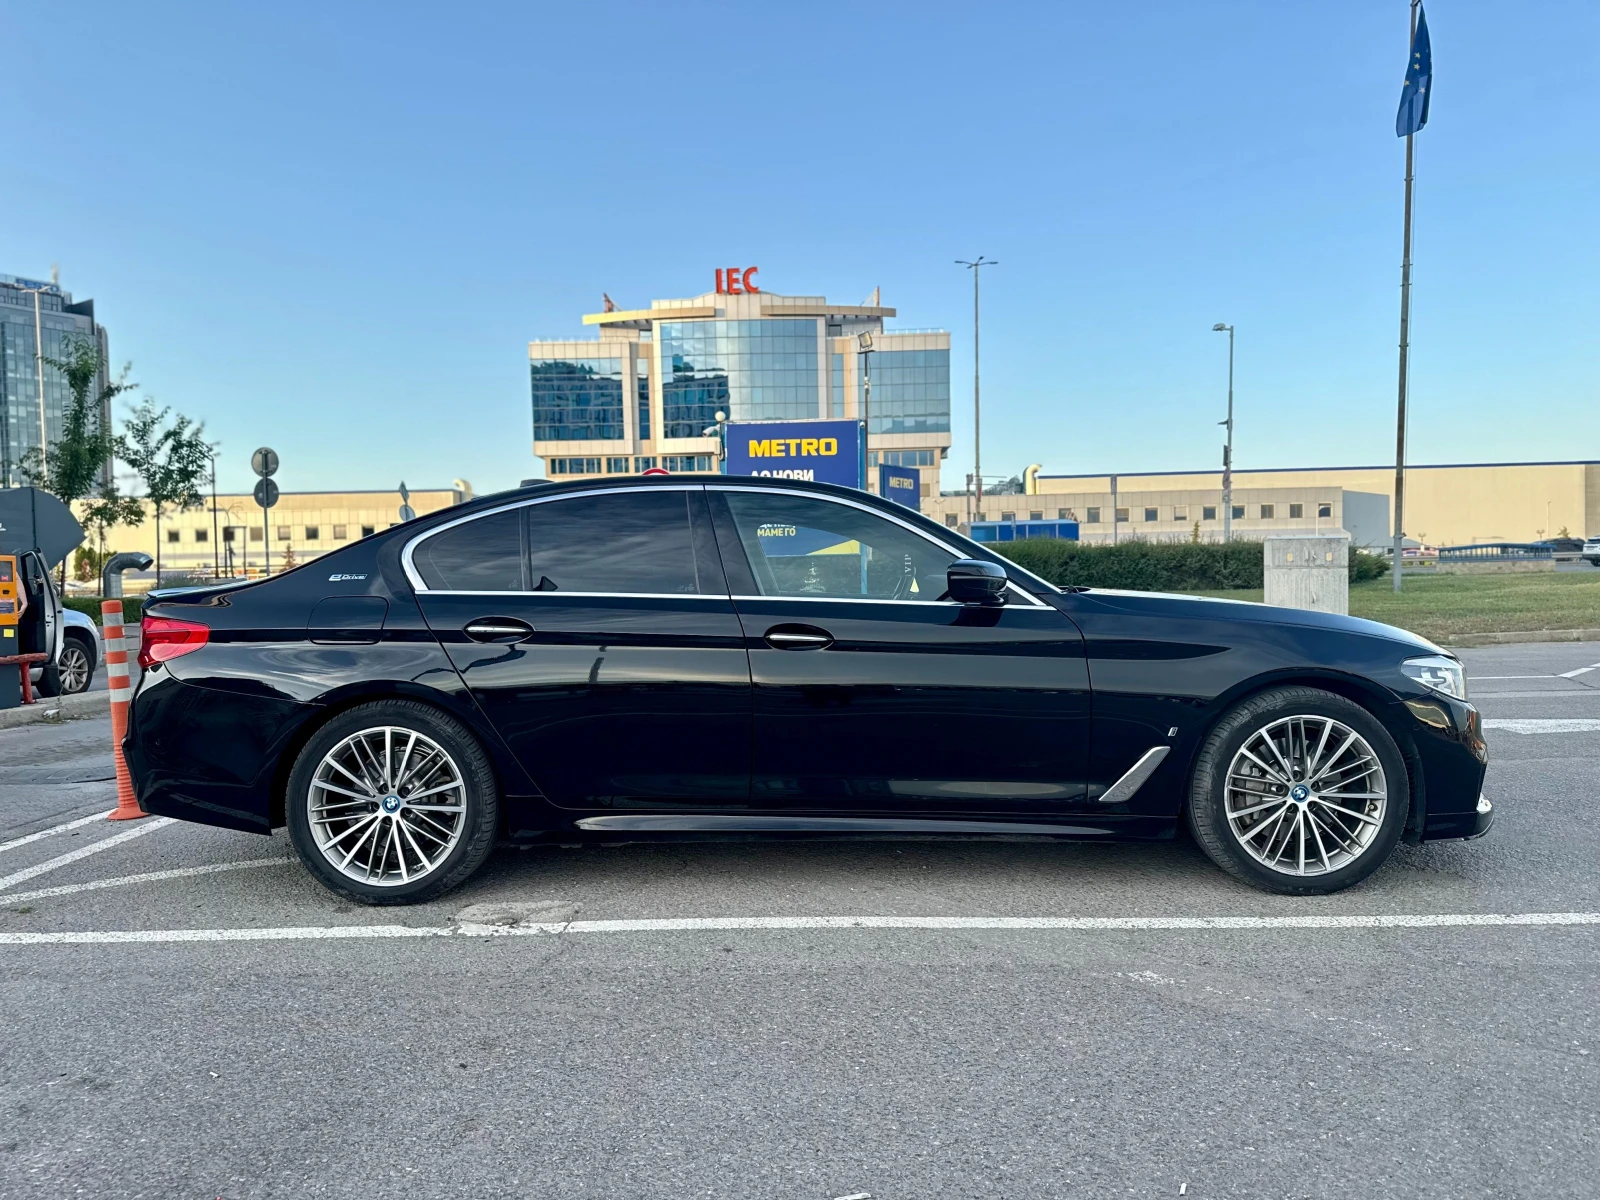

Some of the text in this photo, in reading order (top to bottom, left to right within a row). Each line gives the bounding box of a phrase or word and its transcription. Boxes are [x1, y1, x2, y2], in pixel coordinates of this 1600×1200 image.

[715, 266, 759, 295] IEC
[748, 437, 838, 458] METRO
[772, 469, 814, 481] НОВИ
[889, 476, 914, 490] METRO
